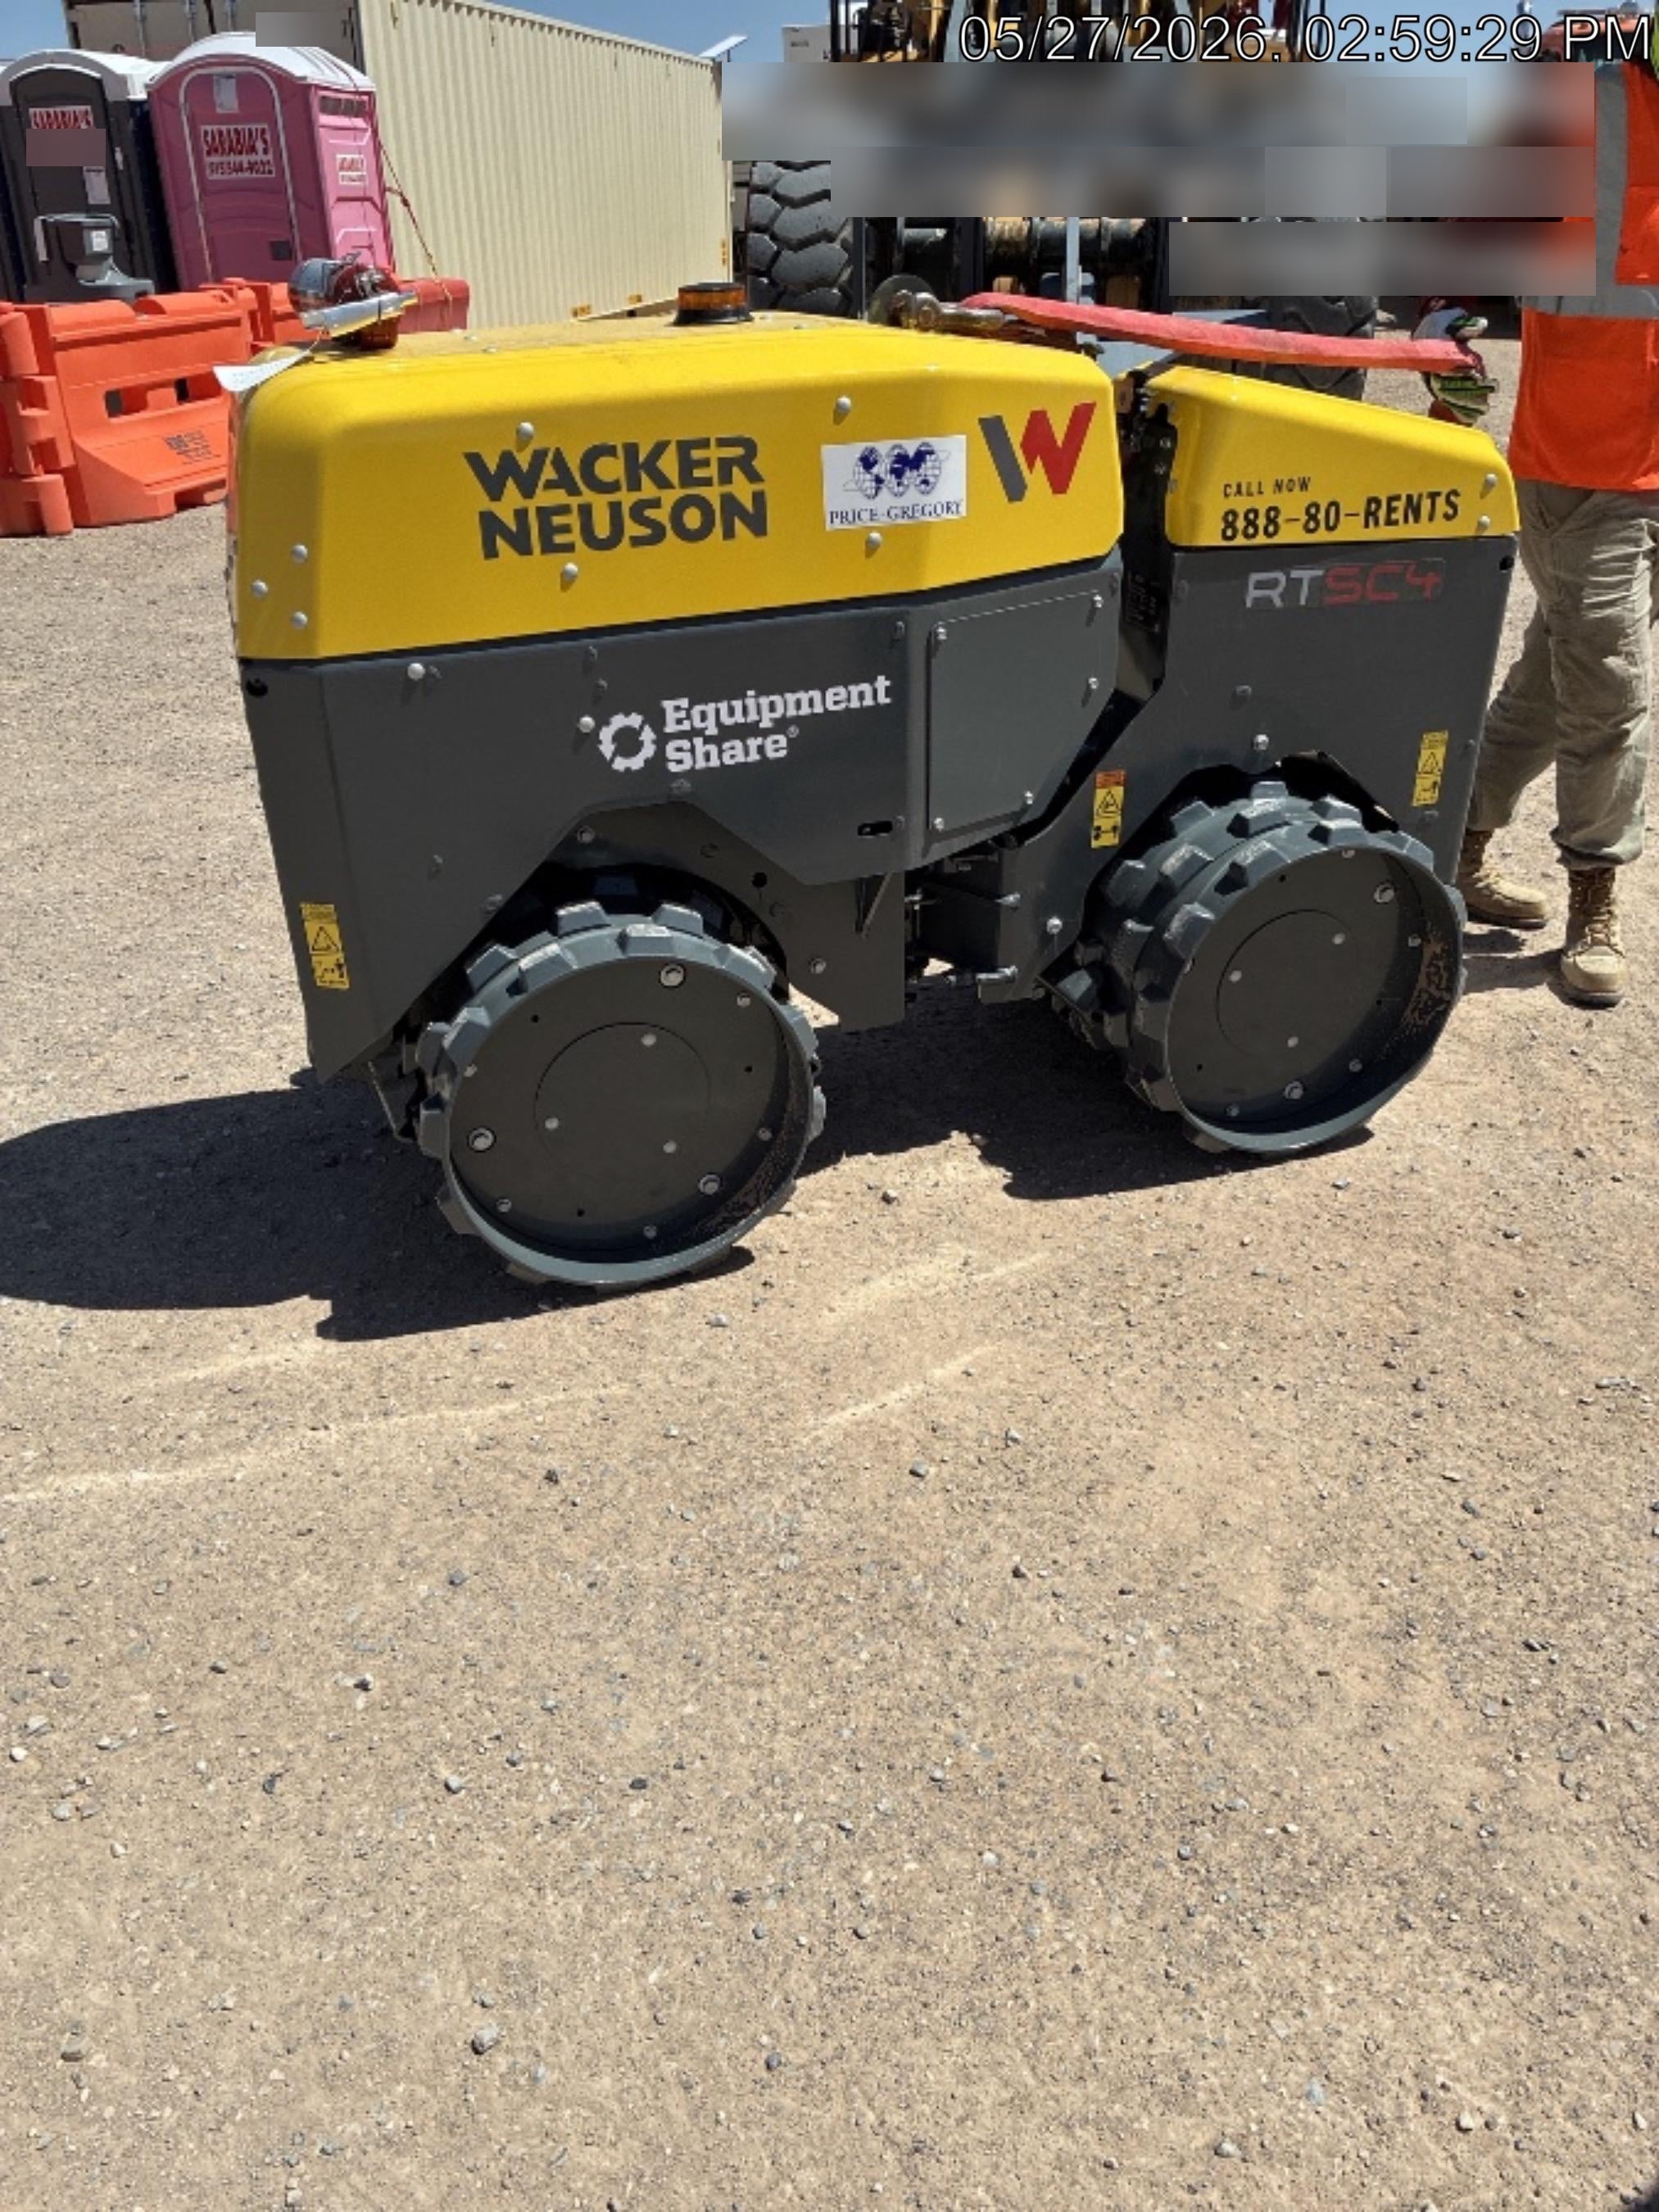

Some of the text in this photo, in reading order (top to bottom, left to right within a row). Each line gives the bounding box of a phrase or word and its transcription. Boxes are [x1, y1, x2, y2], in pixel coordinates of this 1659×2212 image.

[203, 127, 269, 156] SARABIA'S
[463, 434, 765, 502] WACKER
[1223, 476, 1311, 498] CALL NOW
[478, 489, 768, 560] NEUSON
[1222, 488, 1461, 542] 888-80-RENTS
[1245, 560, 1442, 609] RTSC4
[661, 675, 892, 735] Equipment
